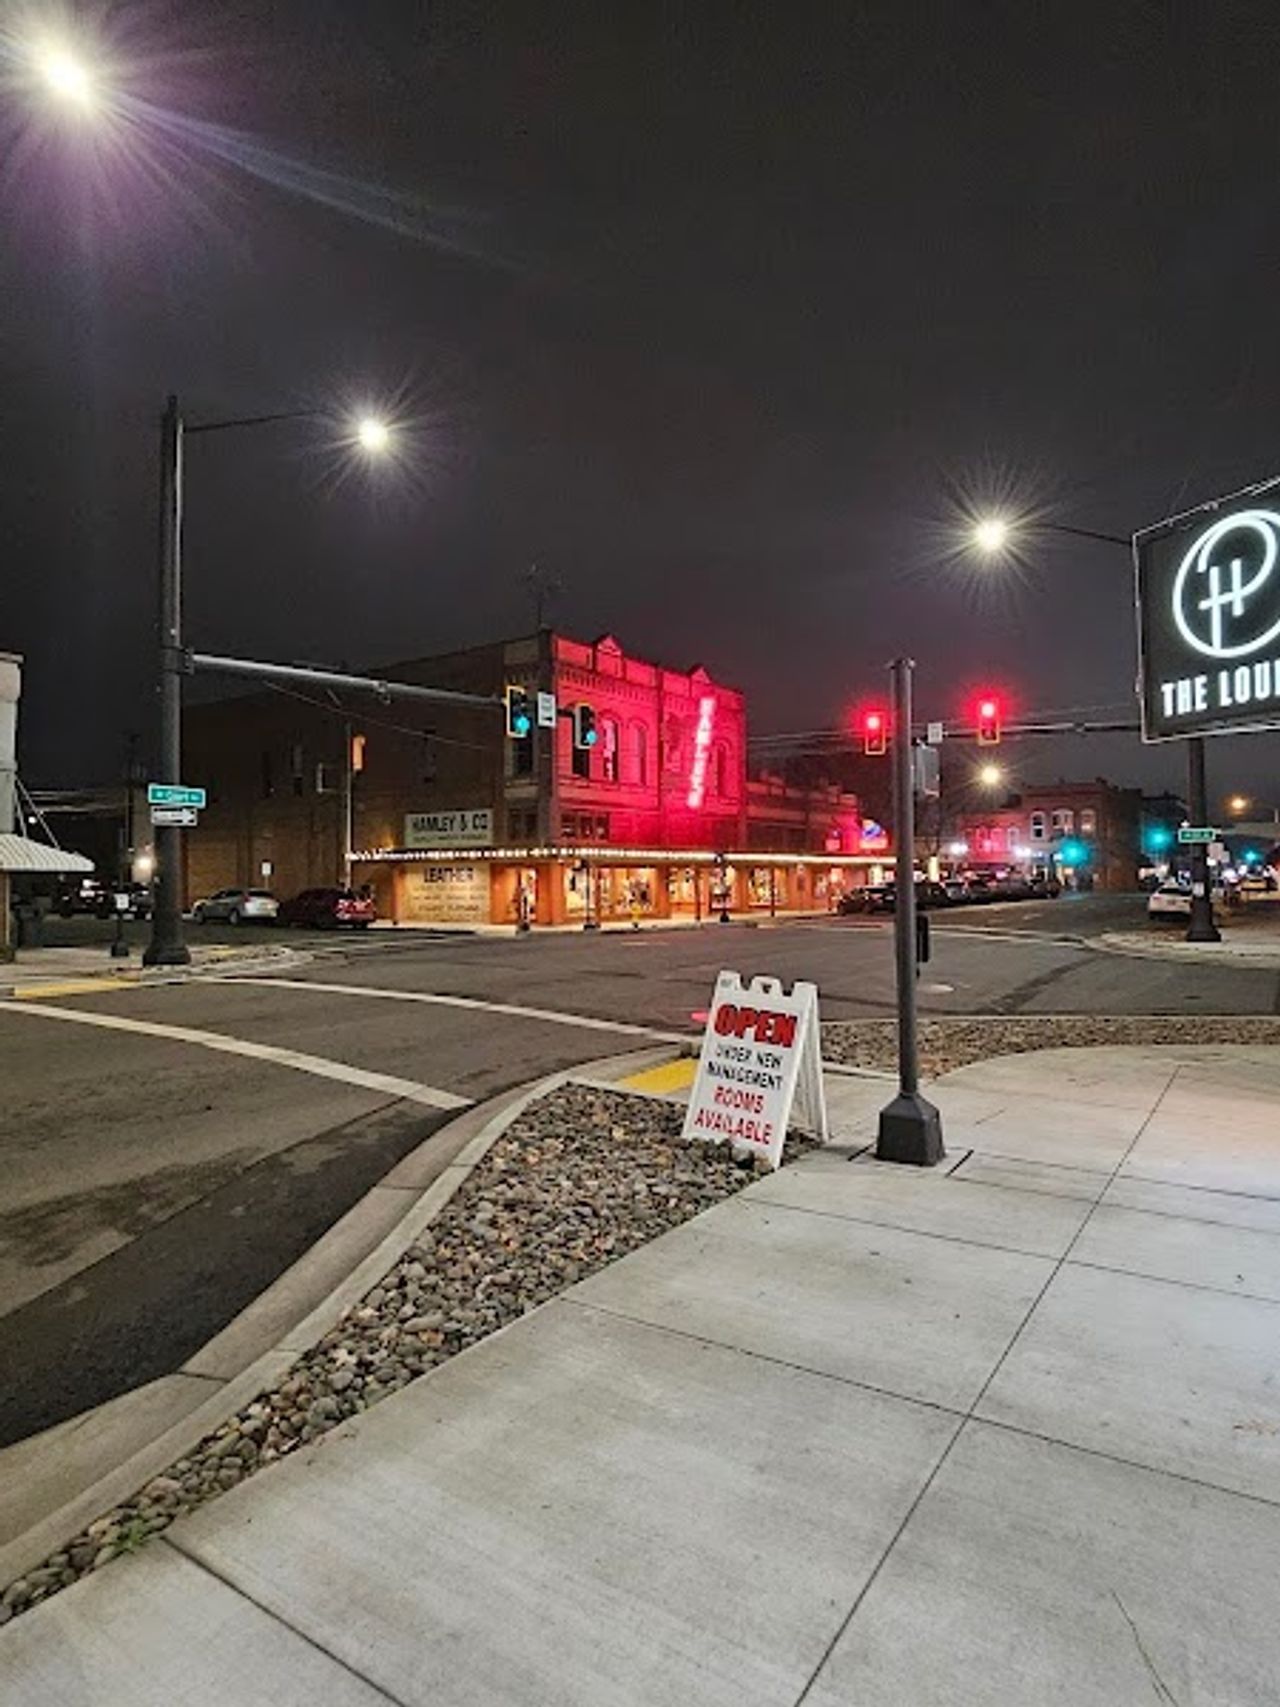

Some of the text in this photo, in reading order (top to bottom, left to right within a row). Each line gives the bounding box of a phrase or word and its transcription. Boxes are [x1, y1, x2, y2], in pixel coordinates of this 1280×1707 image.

[1161, 674, 1208, 718] THE
[413, 815, 456, 831] HAMLEY
[472, 813, 488, 830] CO
[424, 867, 473, 883] LEATHER
[715, 1004, 797, 1047] OPEN
[717, 1044, 784, 1069] UNDER NEW
[707, 1061, 783, 1090] MANAGEMENT
[714, 1085, 765, 1115] ROOMS
[694, 1109, 772, 1145] AVAILABLE
